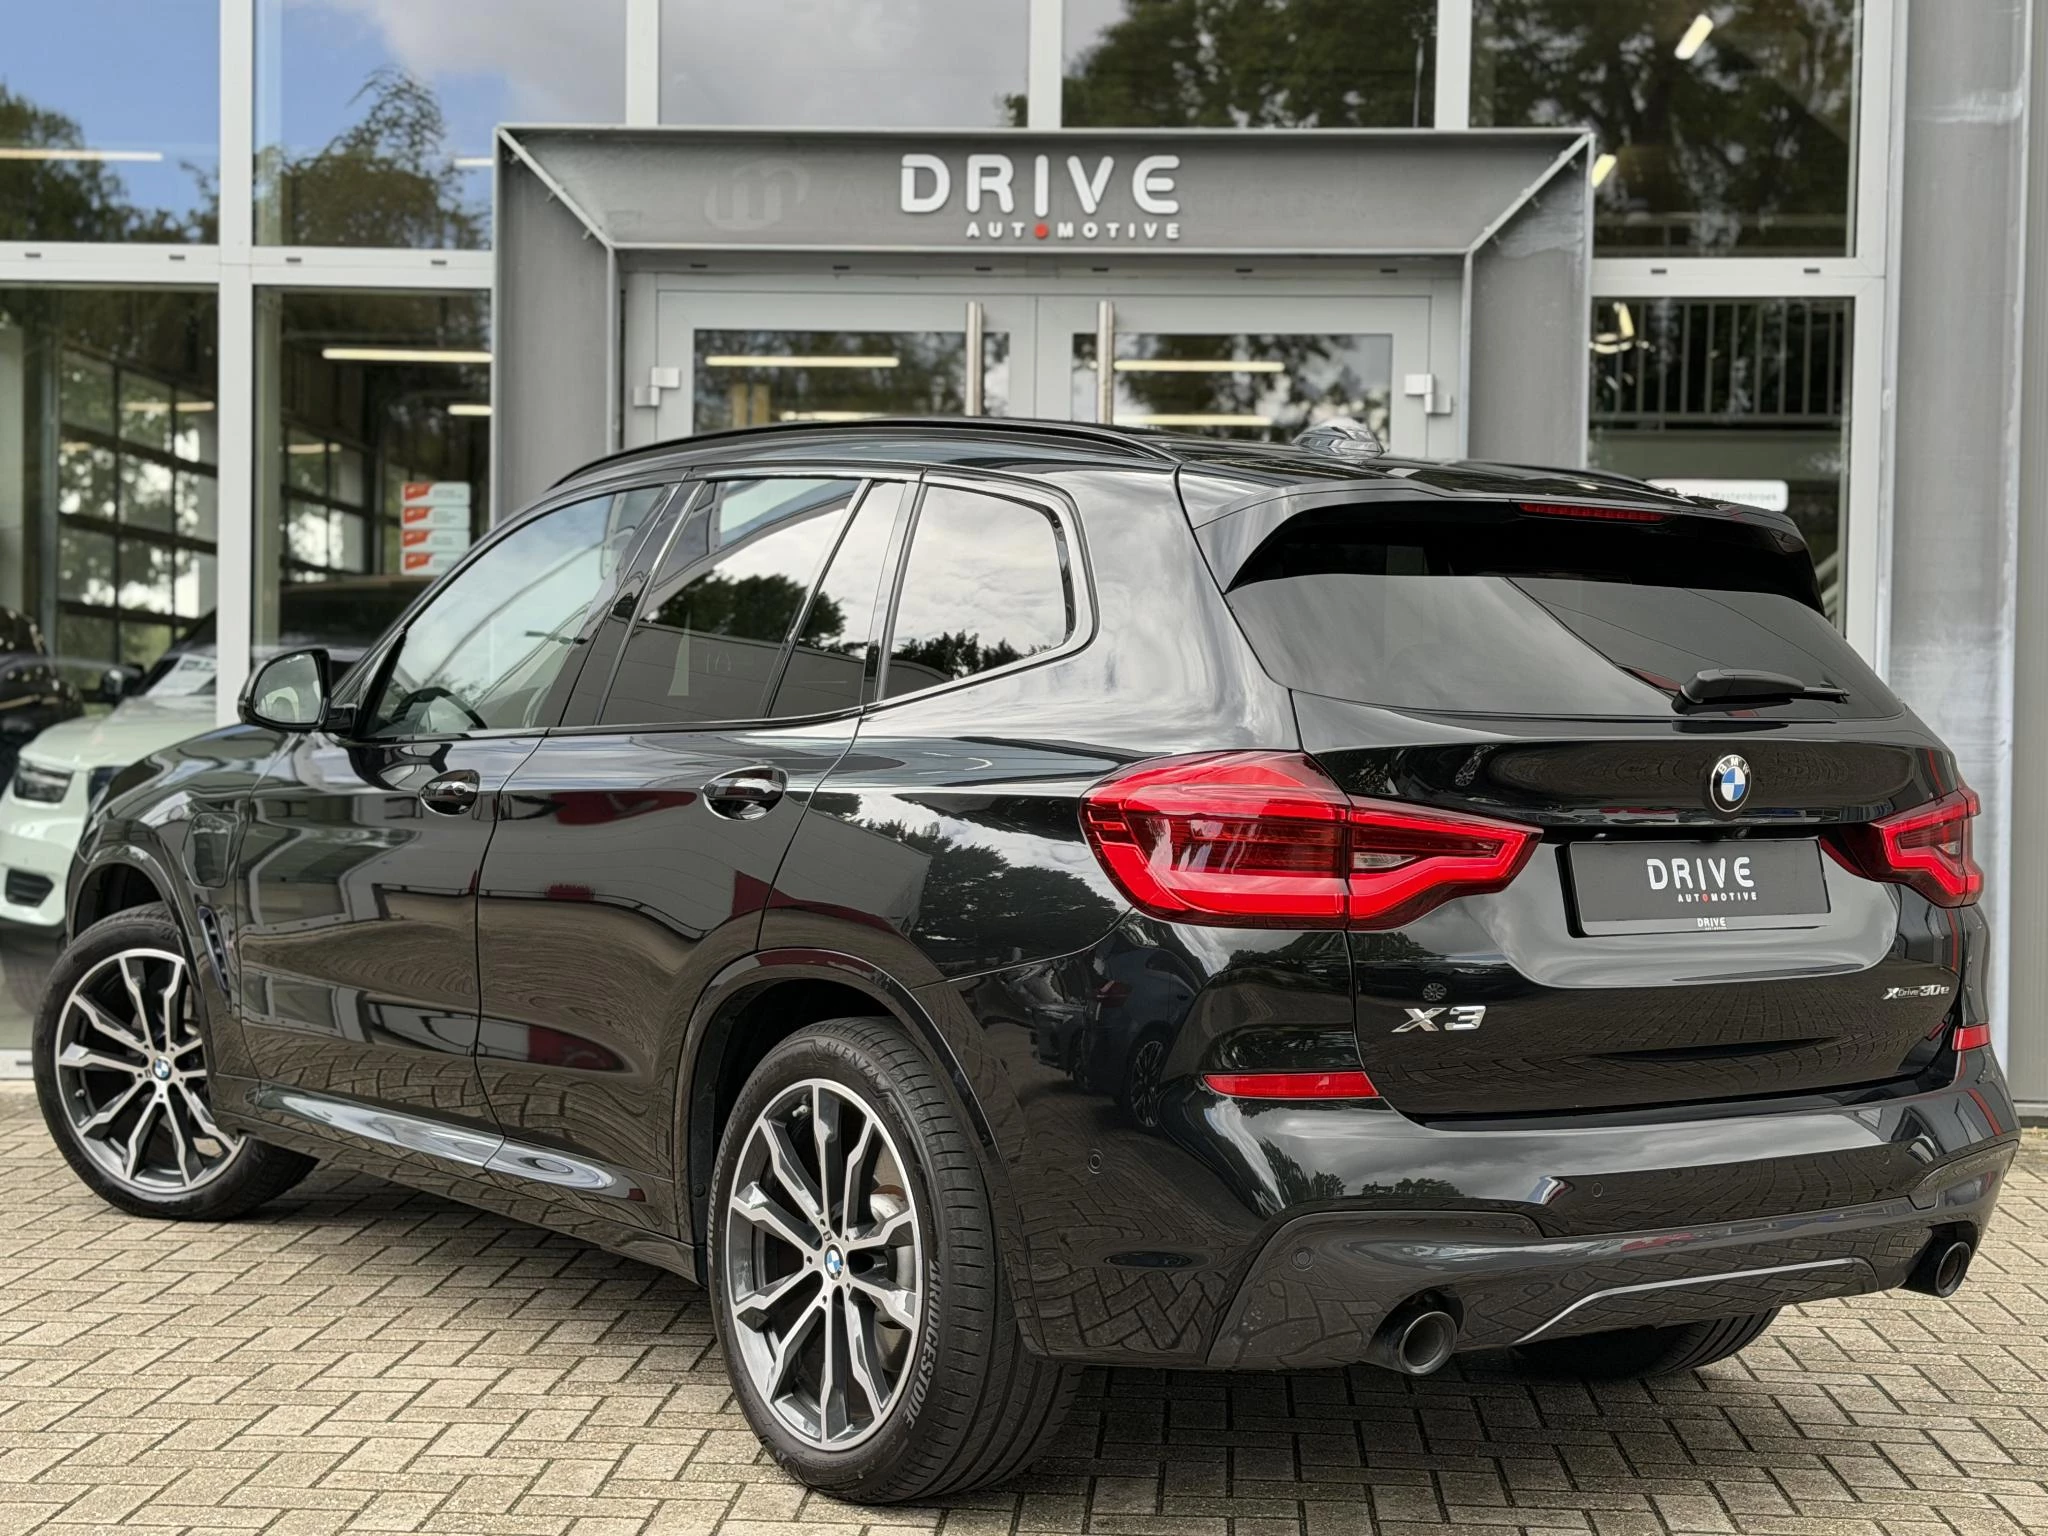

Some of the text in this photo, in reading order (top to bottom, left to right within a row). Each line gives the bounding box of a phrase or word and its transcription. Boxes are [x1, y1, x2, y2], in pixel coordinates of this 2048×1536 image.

[901, 153, 1180, 217] DRIVE
[1646, 856, 1755, 890] DRIVE
[1677, 891, 1757, 903] AUTOMOTIVE
[1696, 917, 1726, 928] DRIVE
[1391, 1005, 1486, 1033] X3
[824, 1041, 880, 1089] ALENZA
[903, 1258, 943, 1430] BRIDGESTONE
